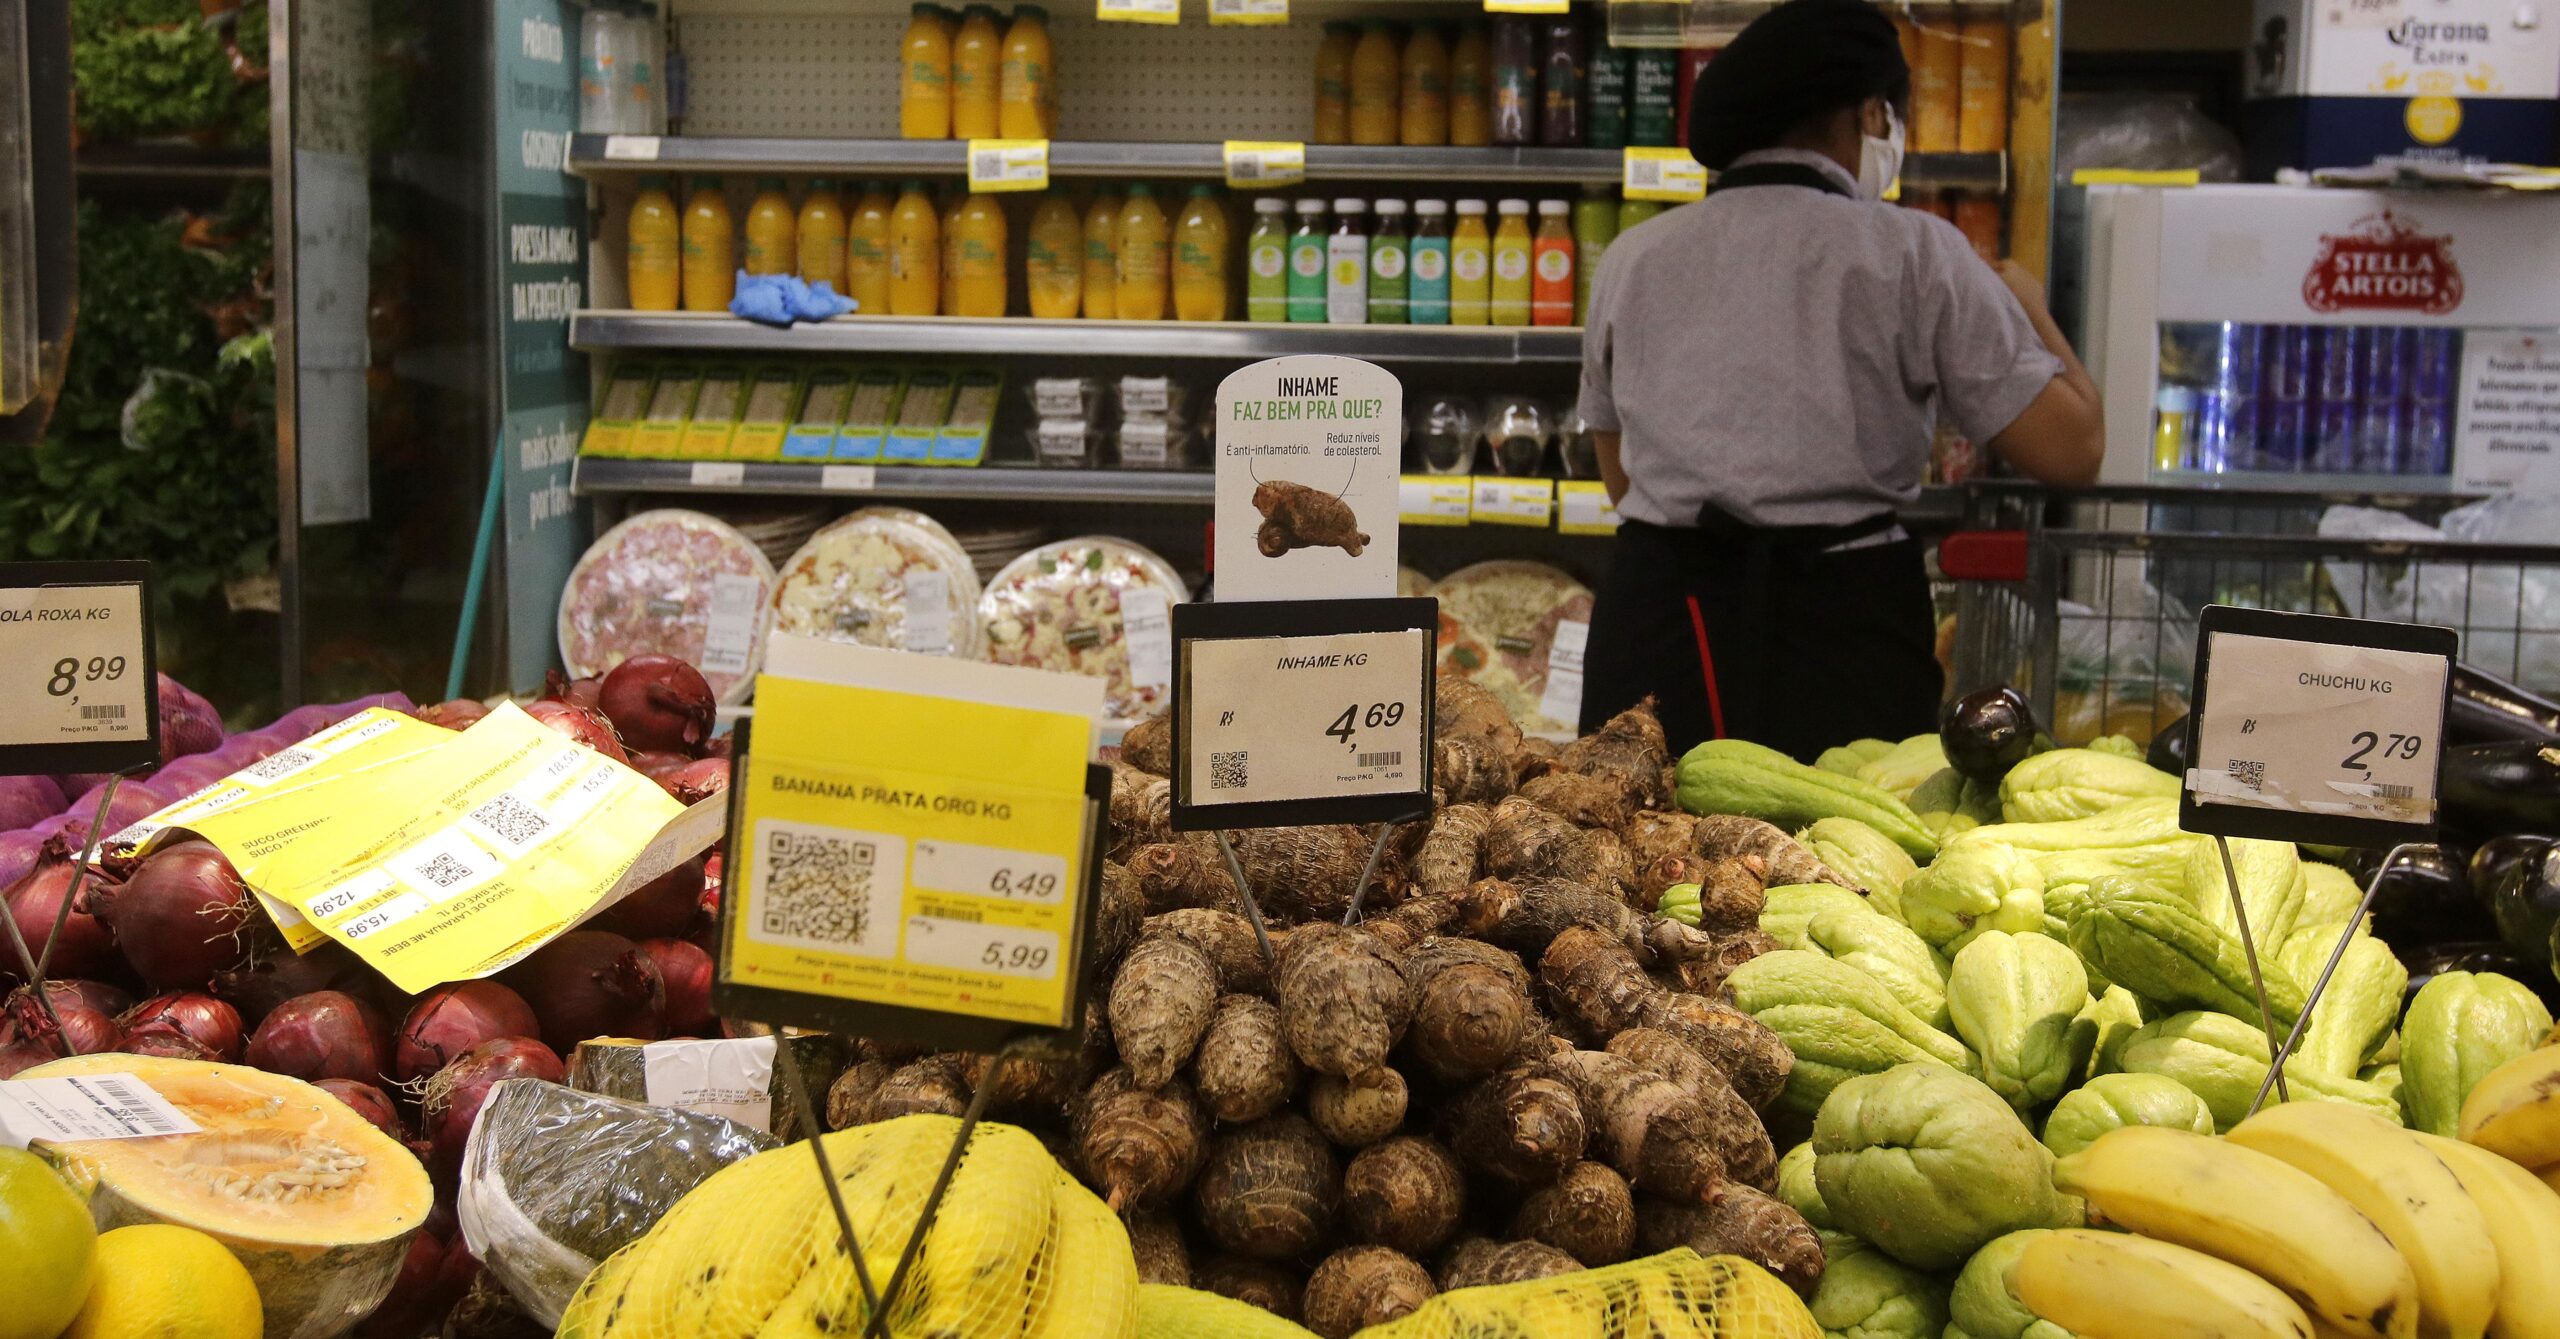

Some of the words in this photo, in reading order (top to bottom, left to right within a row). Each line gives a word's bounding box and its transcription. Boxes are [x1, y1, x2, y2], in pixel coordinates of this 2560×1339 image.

[2386, 16, 2490, 45] Corona
[2413, 45, 2469, 65] Extra
[2334, 252, 2434, 273] STELLA
[2332, 275, 2435, 296] ARTOIS
[1278, 377, 1339, 397] INHAME
[1234, 401, 1262, 421] FAZ
[1267, 400, 1301, 420] BEM
[1306, 400, 1337, 419] PRA
[1342, 399, 1382, 419] QUE?
[1327, 433, 1353, 443] Reduz
[1355, 431, 1380, 443] níveis
[1226, 443, 1232, 456] É
[1234, 444, 1310, 456] anti-inflamatório.
[1324, 446, 1335, 456] de
[1336, 445, 1382, 456] colesterol.
[1, 610, 32, 622] OLA
[38, 608, 82, 621] ROXA
[86, 608, 111, 620] KG
[1277, 654, 1342, 670] INHAME
[1343, 653, 1368, 667] KG
[47, 656, 126, 706] 8,99
[2299, 672, 2367, 691] CHUCHU
[2369, 680, 2393, 694] KG
[1219, 710, 1234, 727] R$
[1325, 702, 1405, 754] 4,69
[547, 748, 580, 777] 18,59
[2341, 731, 2422, 782] 2,79
[582, 764, 615, 793] 15,59
[1357, 773, 1374, 781] P/KG
[442, 788, 467, 805] SUCO
[771, 776, 856, 802] BANANA
[861, 788, 927, 811] PRATA
[932, 795, 977, 817] ORG
[982, 803, 1011, 821] KG
[242, 834, 275, 850] SUCO
[249, 843, 283, 858] SUCO
[489, 881, 505, 892] NA
[990, 868, 1057, 898] 6,49
[313, 890, 356, 918] 12,99
[468, 888, 491, 904] BIKE
[487, 887, 515, 905] SUCO
[452, 900, 467, 913] GP
[473, 901, 488, 914] DE
[346, 913, 390, 939] 15,99
[427, 908, 474, 936] LARANJA
[410, 932, 429, 944] ME
[381, 939, 412, 958] BEBE
[981, 942, 1049, 971] 5,99
